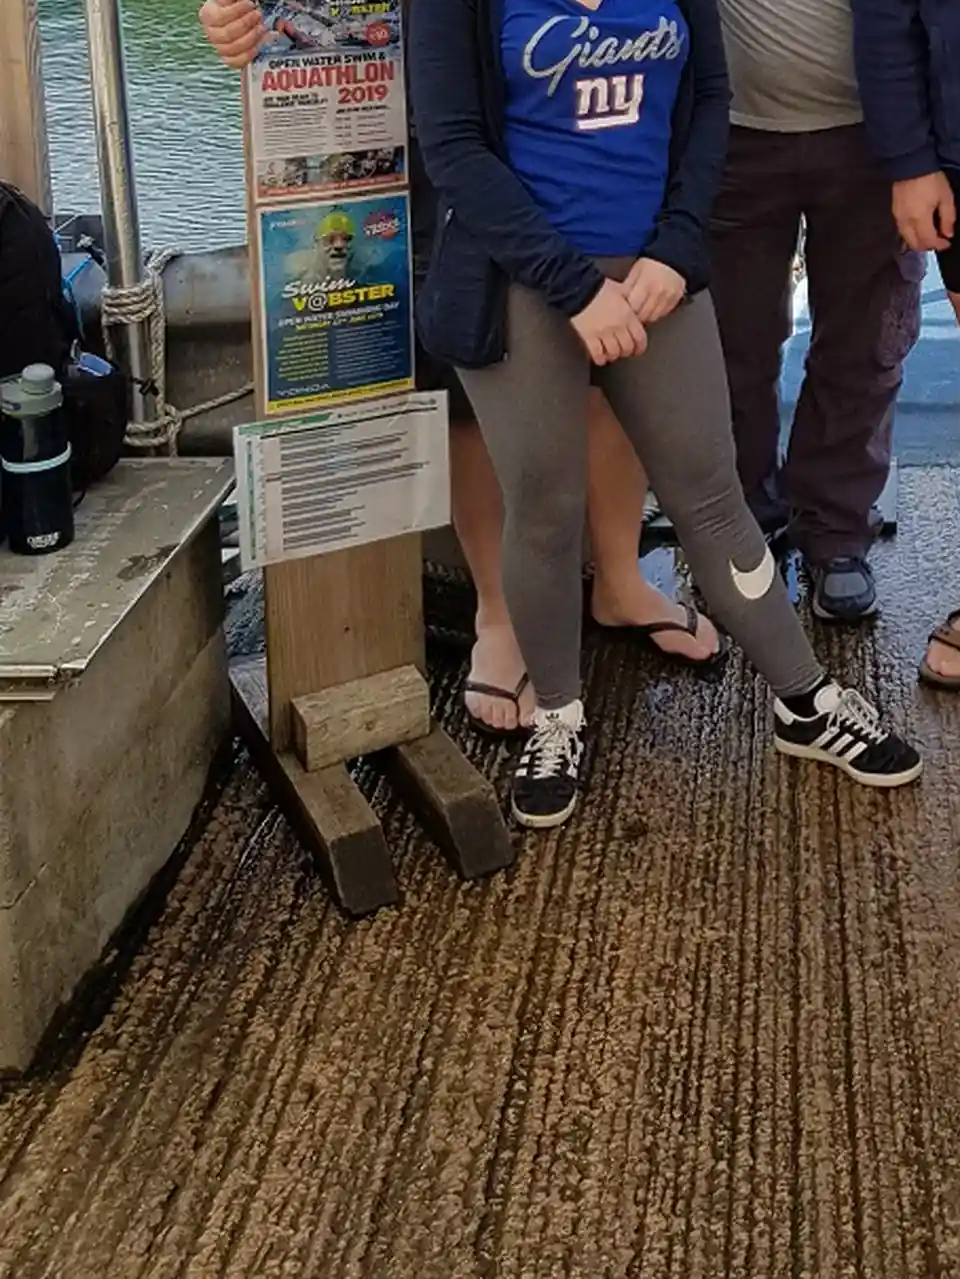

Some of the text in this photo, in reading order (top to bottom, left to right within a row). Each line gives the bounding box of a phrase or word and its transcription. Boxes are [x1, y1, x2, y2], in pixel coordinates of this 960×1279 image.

[269, 59, 300, 70] OPEN
[302, 55, 341, 67] WATER
[344, 52, 377, 64] SWIM
[523, 15, 685, 97] Giants
[262, 61, 394, 93] AQUATHLON
[337, 84, 389, 105] 2019
[281, 276, 356, 298] Swim
[292, 284, 396, 312] V@BSTER
